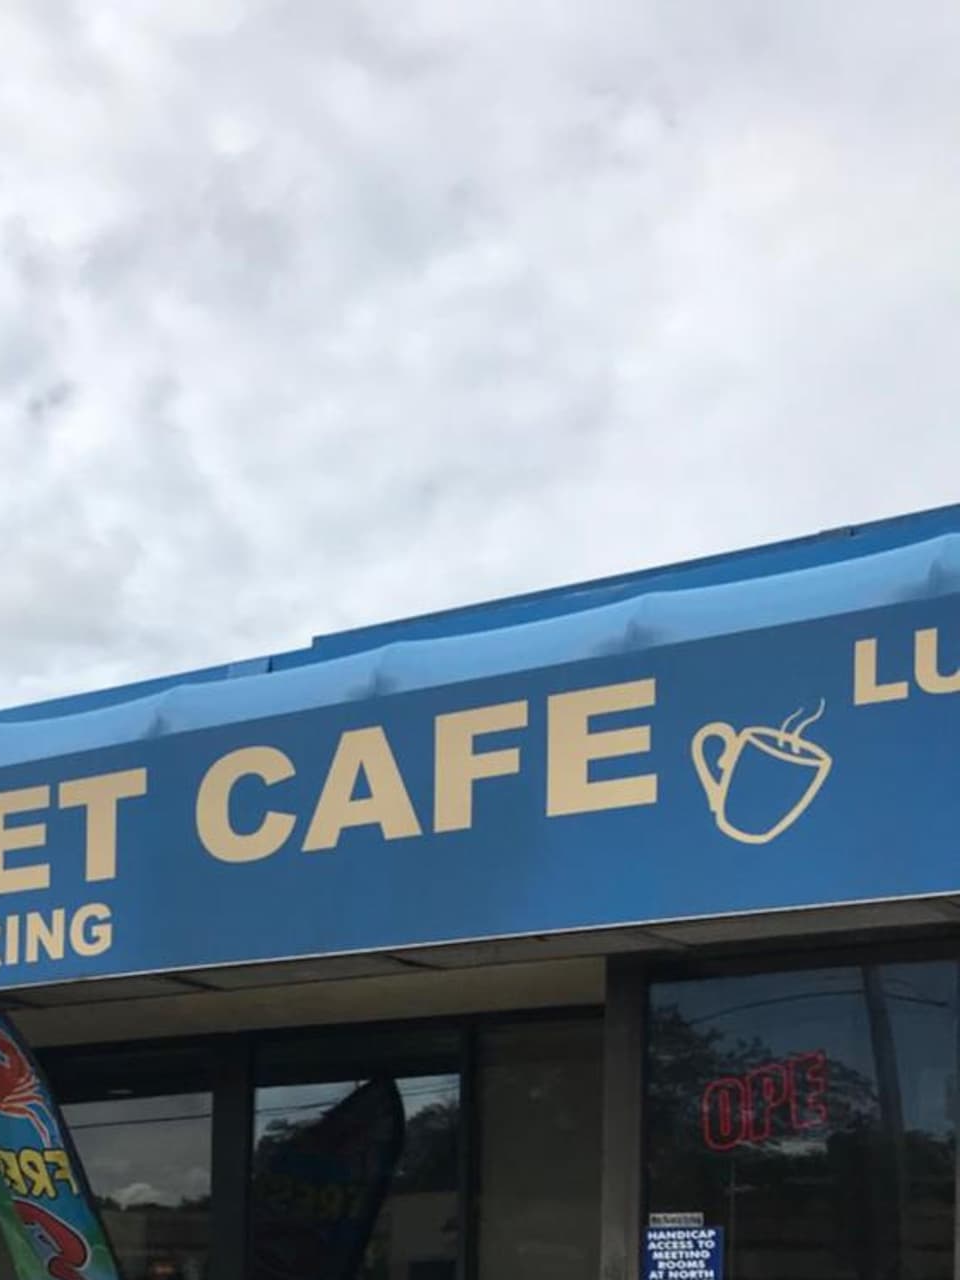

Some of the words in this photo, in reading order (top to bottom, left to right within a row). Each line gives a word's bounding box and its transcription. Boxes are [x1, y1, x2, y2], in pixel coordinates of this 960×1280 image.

[195, 677, 658, 863] CAFE
[647, 1229, 716, 1240] HANDICAP
[647, 1240, 693, 1250] ACCESS
[697, 1240, 715, 1249] TO
[652, 1250, 710, 1260] MEETING
[658, 1260, 706, 1270] ROOMS
[649, 1270, 664, 1279] AT
[668, 1269, 714, 1279] NORTH
